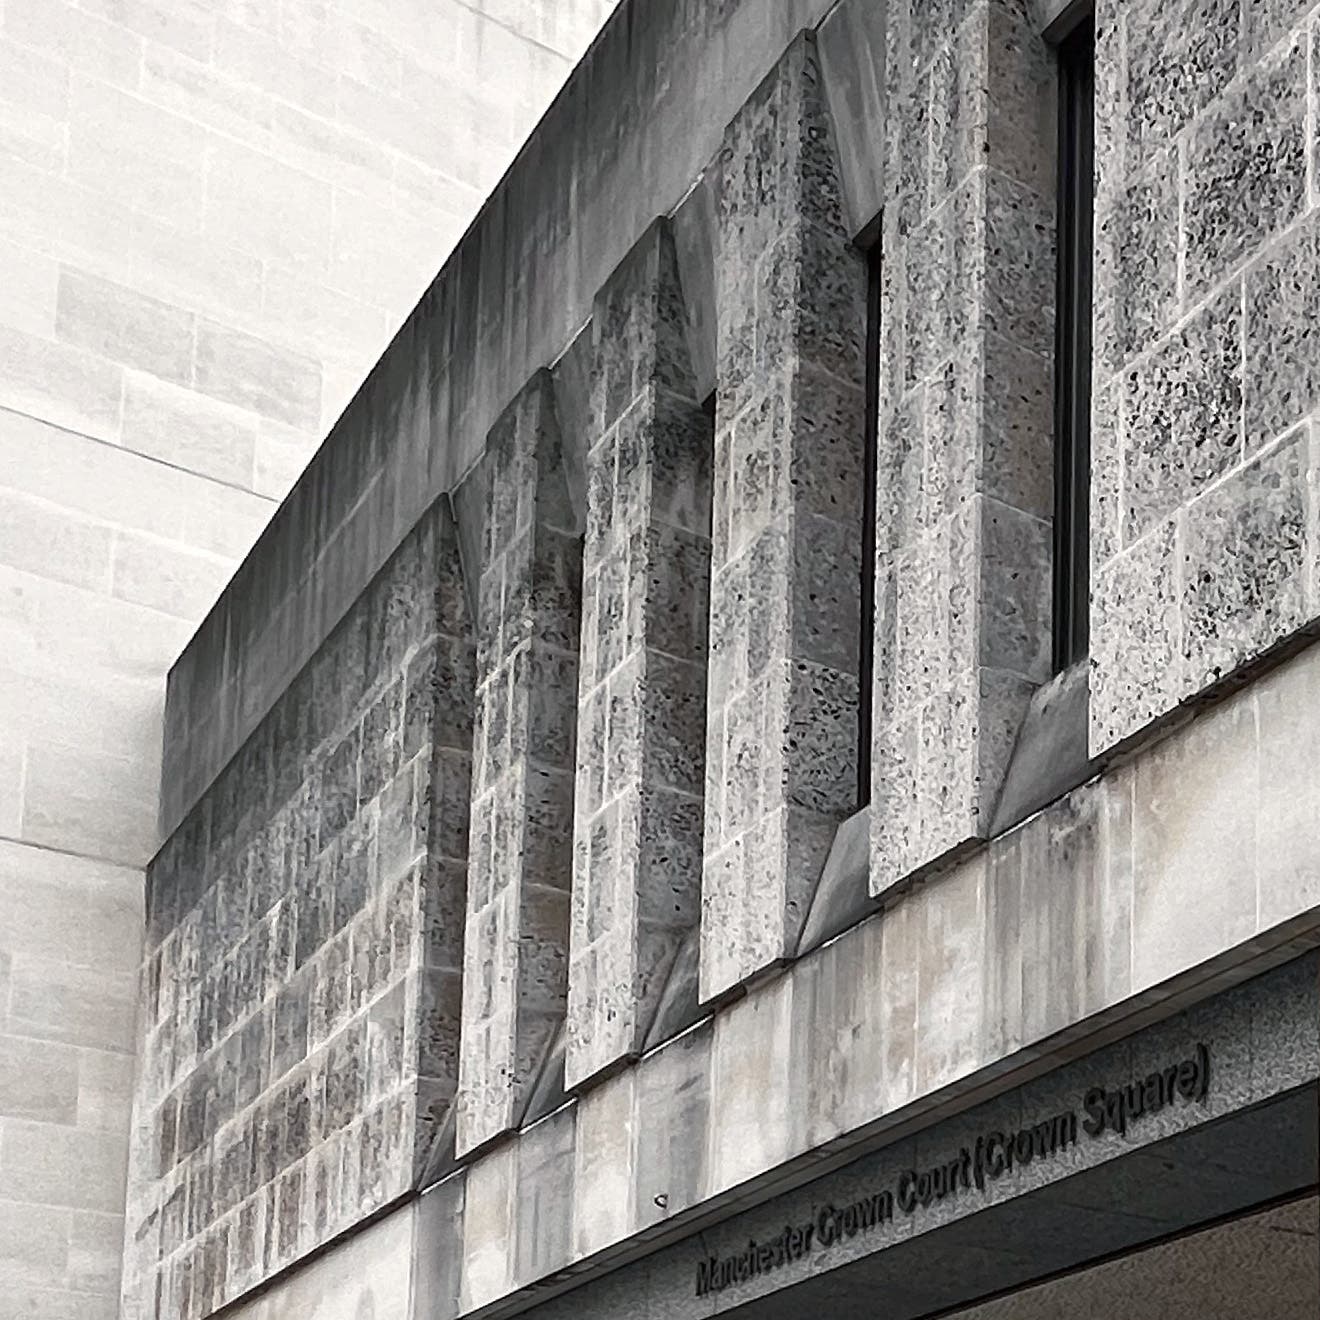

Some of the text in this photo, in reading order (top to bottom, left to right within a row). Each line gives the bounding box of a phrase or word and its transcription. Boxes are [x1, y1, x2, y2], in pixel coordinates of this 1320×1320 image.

[695, 1042, 1210, 1296] Manchester Crown Court (Crown Square)
